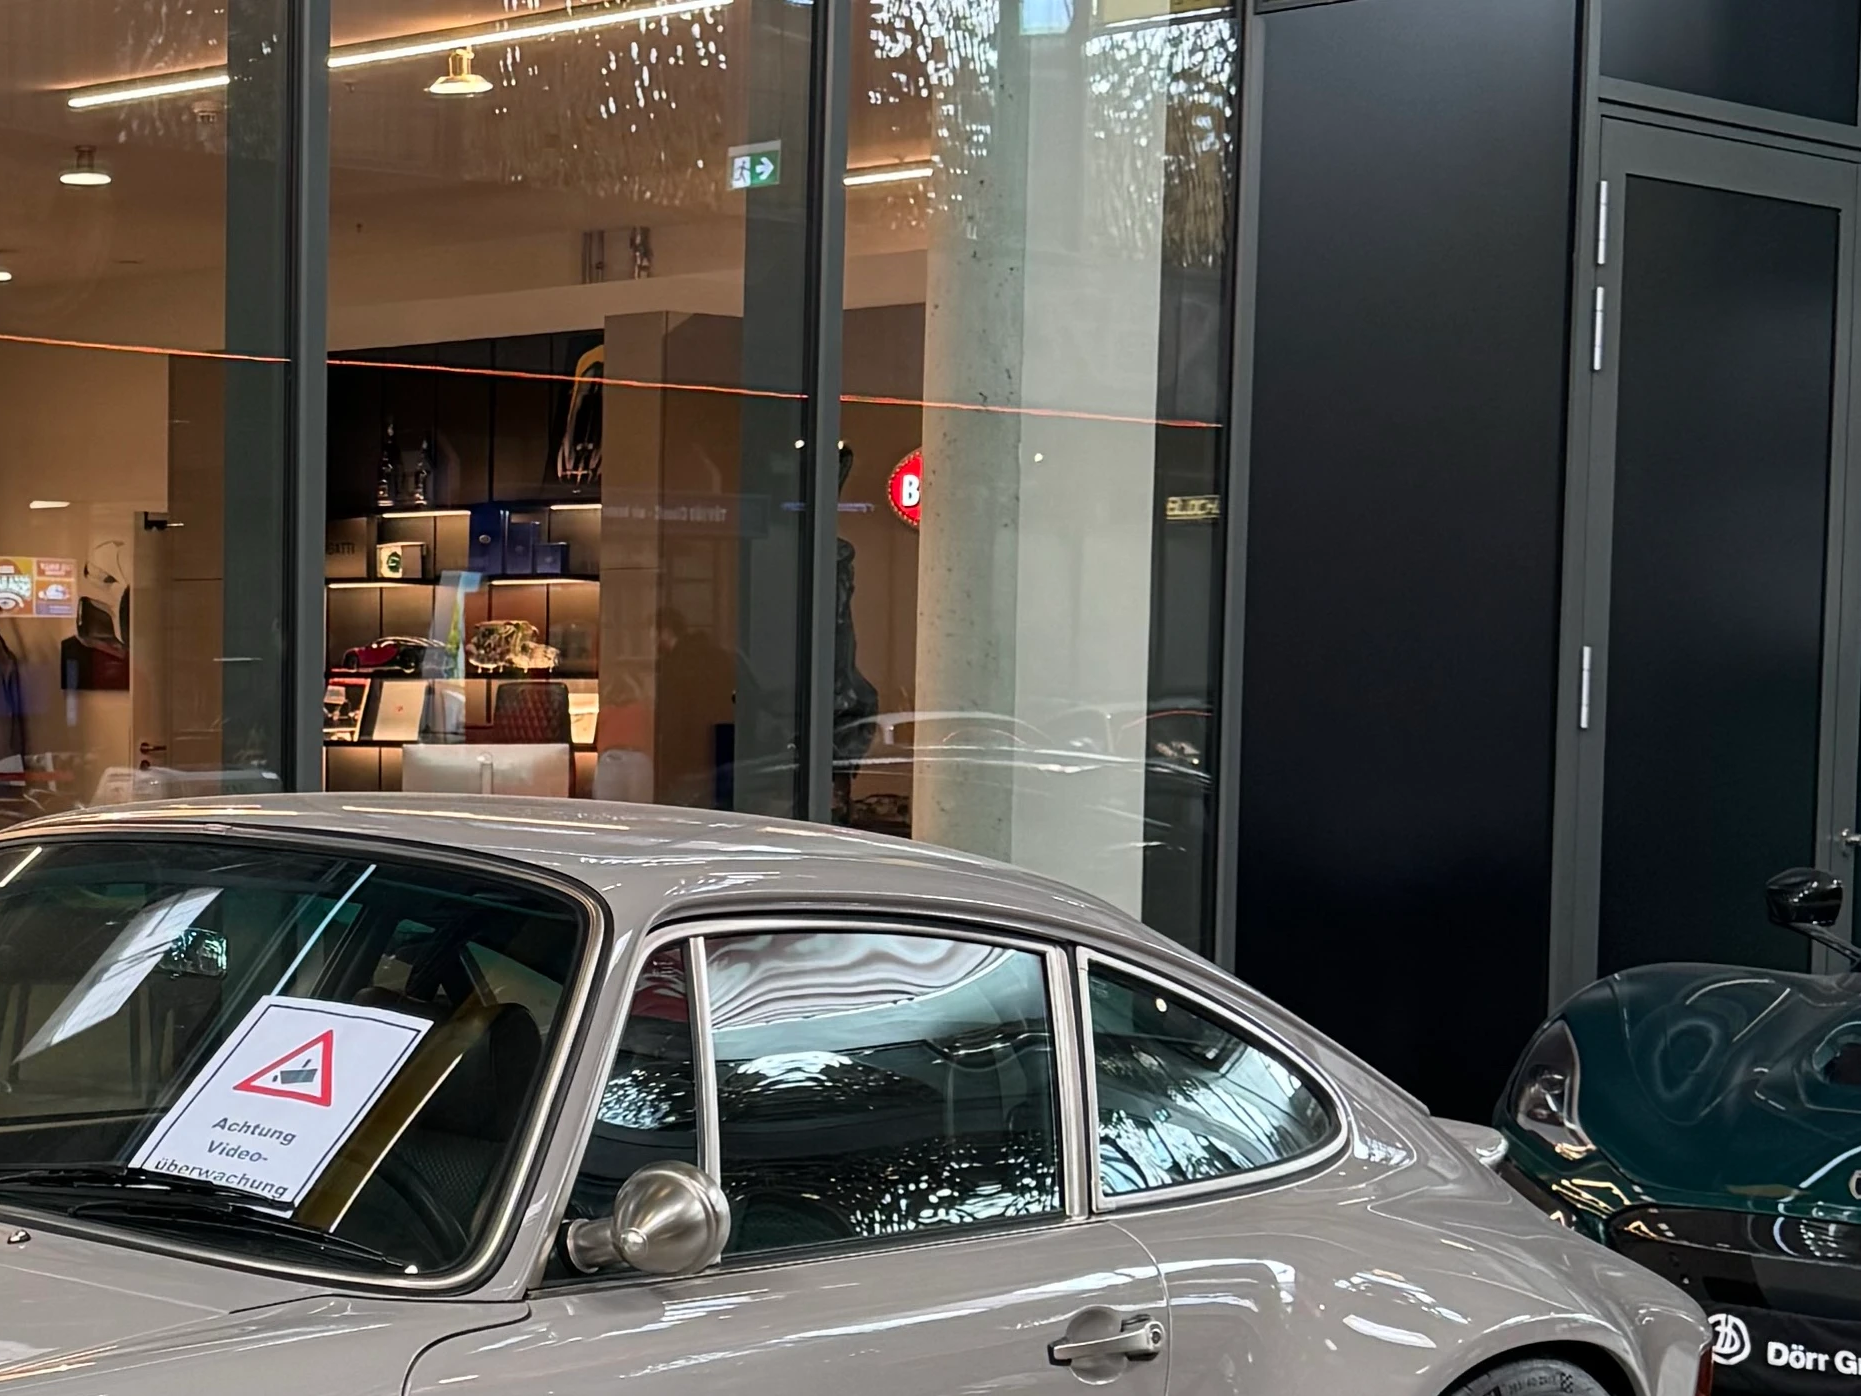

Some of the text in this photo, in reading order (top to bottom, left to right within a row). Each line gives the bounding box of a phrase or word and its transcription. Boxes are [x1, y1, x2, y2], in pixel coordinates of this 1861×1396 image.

[902, 474, 921, 507] B
[326, 542, 355, 556] GATTI
[211, 1115, 297, 1147] Achtung
[207, 1139, 269, 1164] Video-
[155, 1157, 289, 1201] überwachung
[1767, 1341, 1861, 1376] Dörr G
